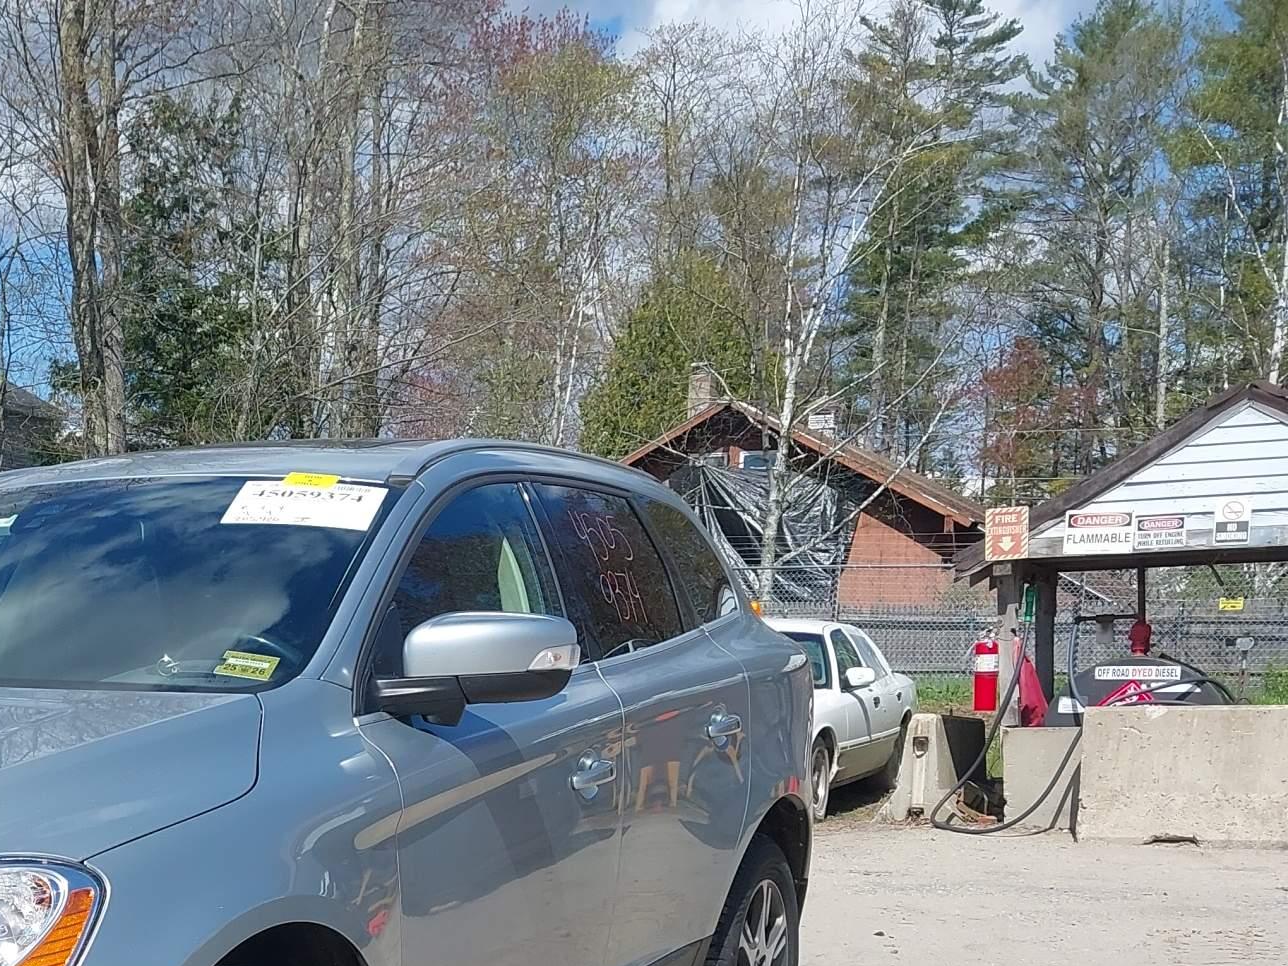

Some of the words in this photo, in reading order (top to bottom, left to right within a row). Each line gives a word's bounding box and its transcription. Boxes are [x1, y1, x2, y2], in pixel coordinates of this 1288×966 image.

[995, 513, 1018, 524] FIRE
[1077, 516, 1123, 525] DANGER
[1144, 520, 1178, 528] DANGER
[1066, 532, 1131, 545] FLAMMABLE
[223, 663, 237, 671] 25
[250, 667, 265, 675] 26
[1097, 669, 1110, 678] OFF
[1112, 669, 1130, 677] ROAD
[1132, 669, 1152, 678] DYED
[1155, 669, 1179, 678] DIESEL
